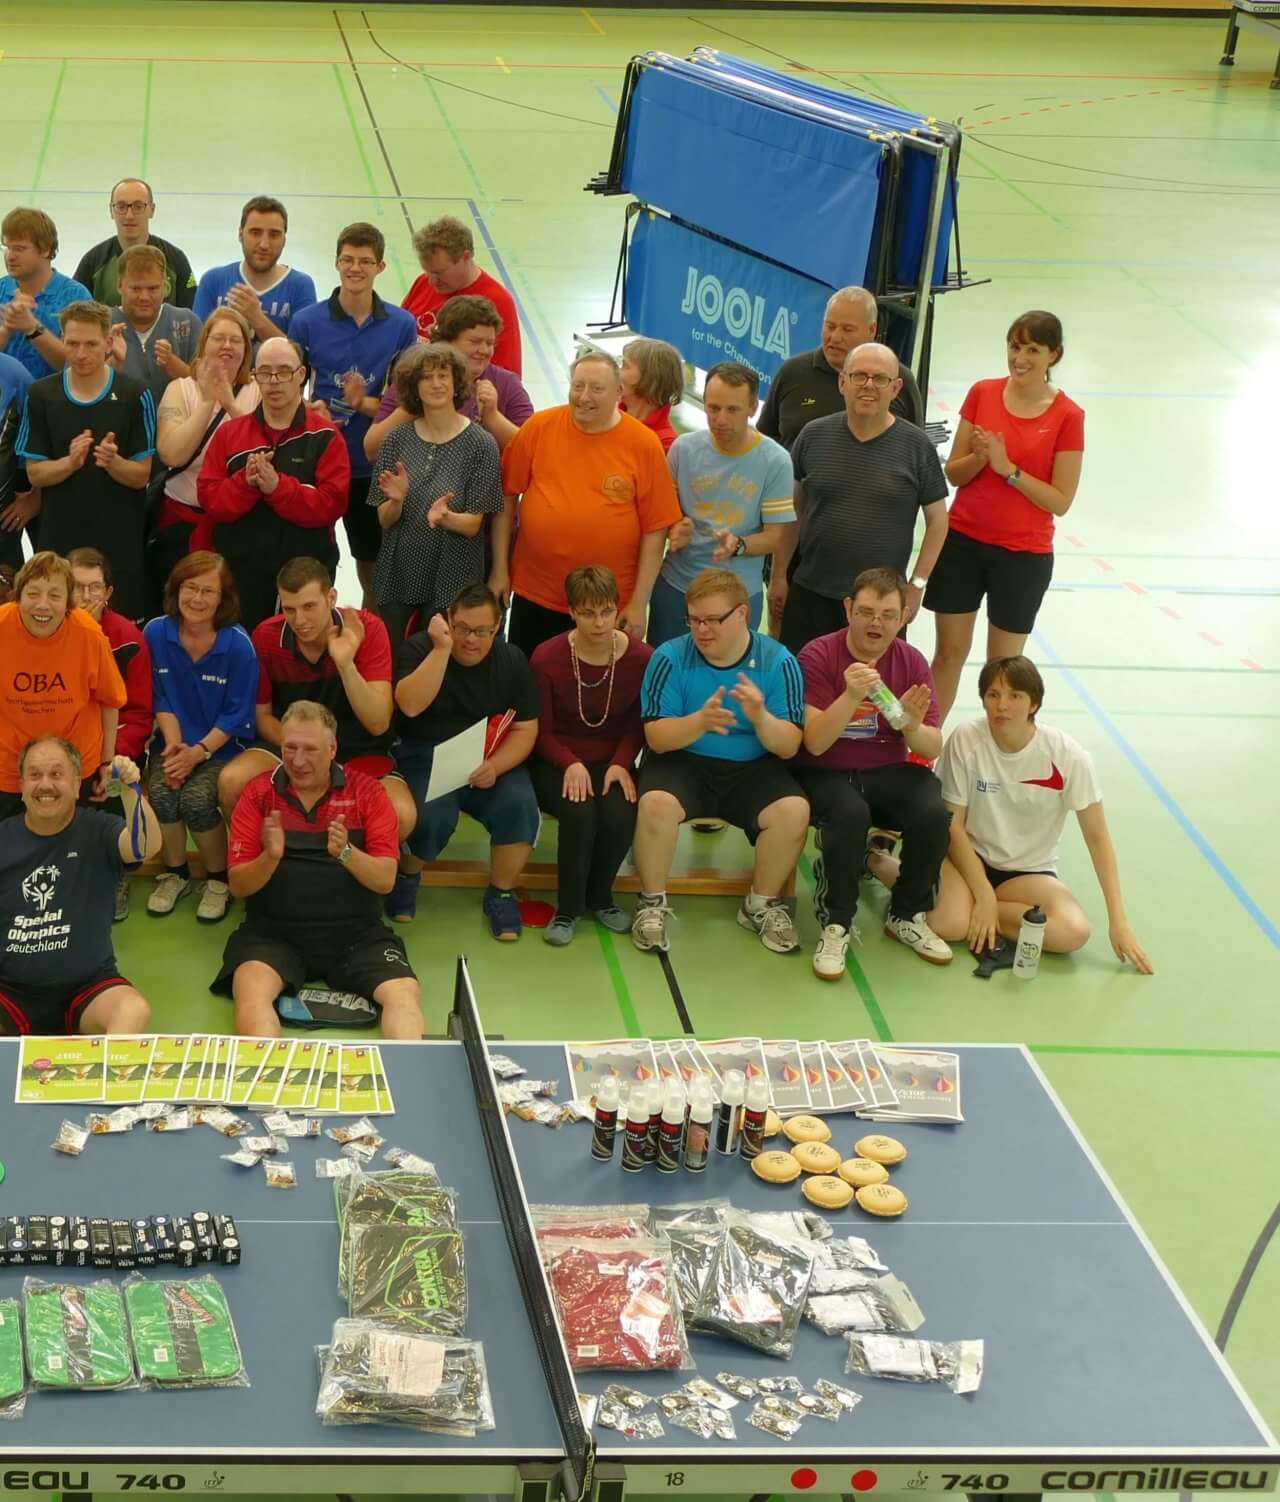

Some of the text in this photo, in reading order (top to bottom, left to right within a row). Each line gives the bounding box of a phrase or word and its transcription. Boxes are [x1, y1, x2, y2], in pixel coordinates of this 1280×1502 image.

[681, 266, 790, 361] JOOLA
[691, 328, 705, 341] for
[706, 333, 722, 348] the
[13, 672, 67, 694] OBA
[7, 924, 71, 942] Olympics
[116, 1474, 186, 1490] 740
[664, 1471, 685, 1486] 18
[940, 1474, 1010, 1490] 740
[1041, 1467, 1269, 1489] cornilleau
